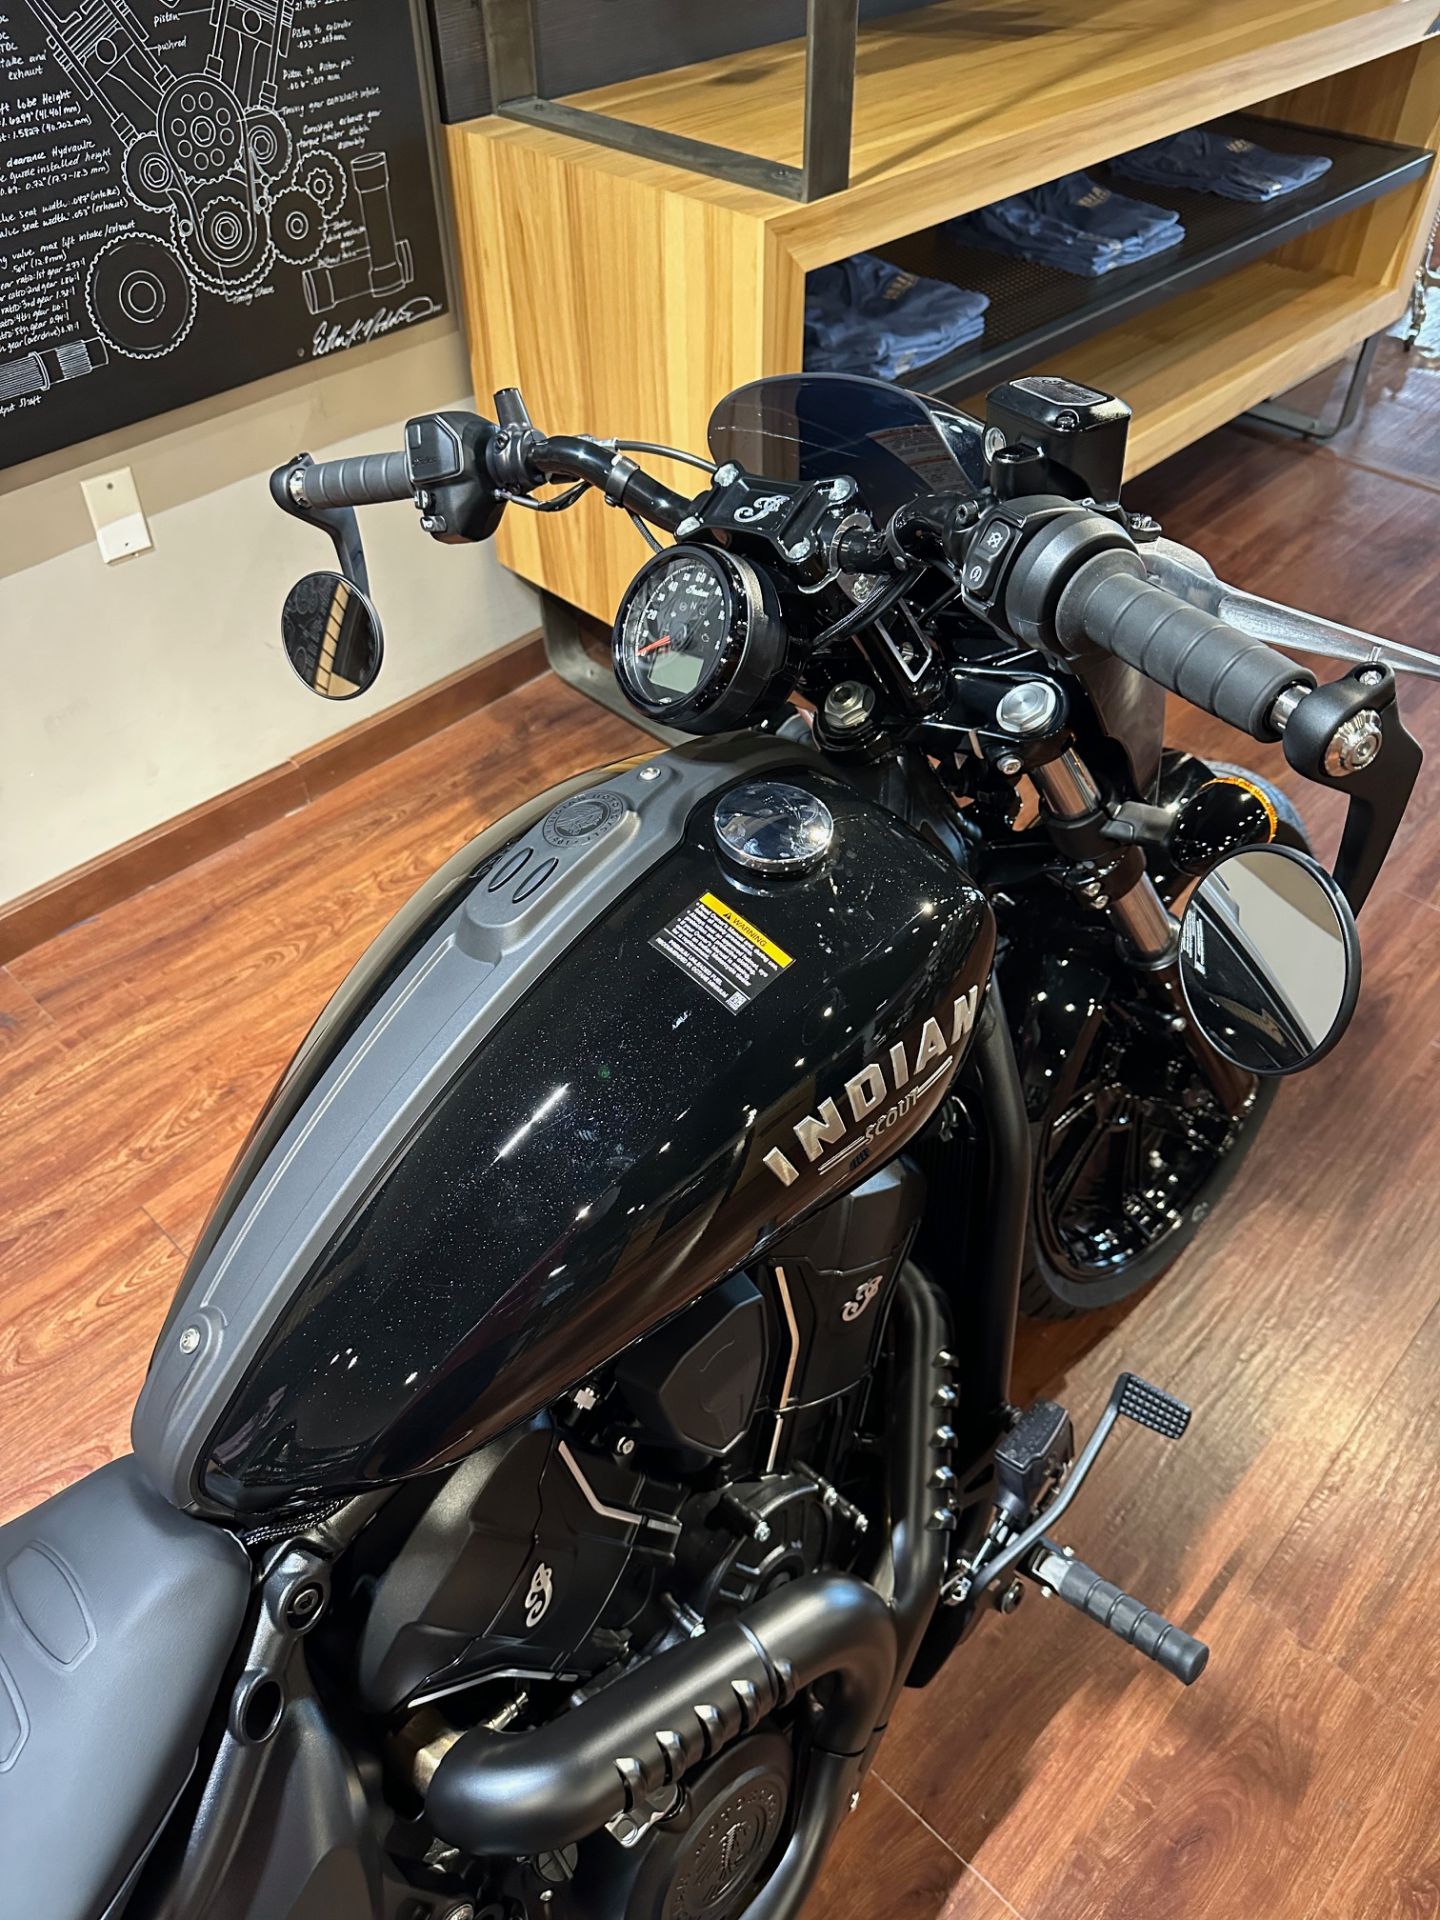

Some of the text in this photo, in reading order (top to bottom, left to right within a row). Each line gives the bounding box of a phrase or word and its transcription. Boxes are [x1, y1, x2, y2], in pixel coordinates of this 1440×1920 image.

[29, 49, 47, 62] and
[8, 65, 43, 80] exhaust
[42, 90, 72, 104] Height
[12, 248, 35, 260] valve
[40, 241, 58, 252] max
[731, 917, 767, 946] WARNING
[763, 985, 979, 1187] INDIAN
[865, 1086, 920, 1144] SCOUT
